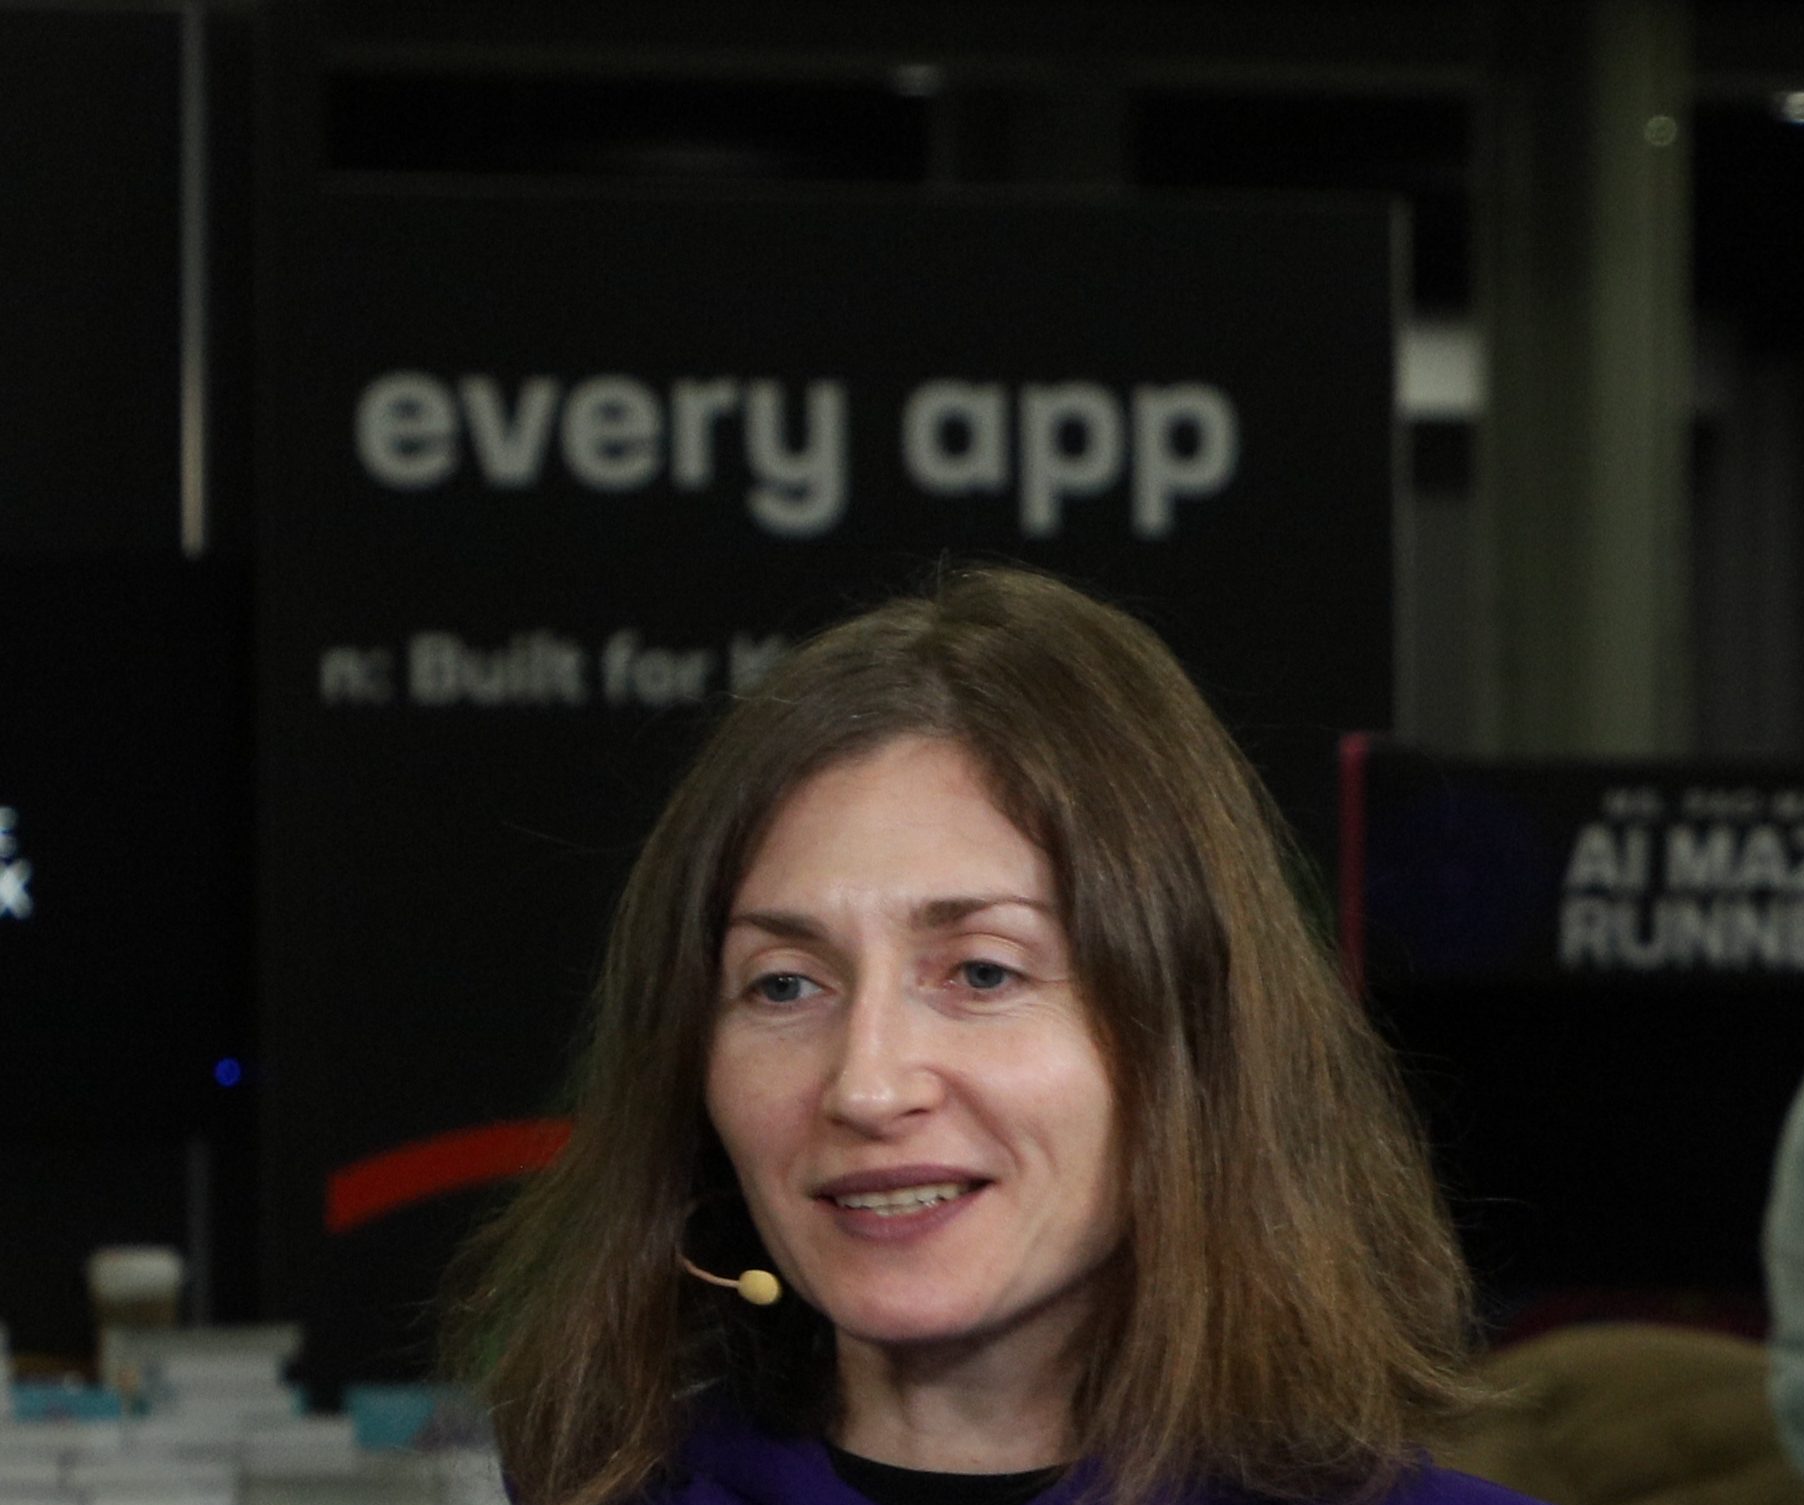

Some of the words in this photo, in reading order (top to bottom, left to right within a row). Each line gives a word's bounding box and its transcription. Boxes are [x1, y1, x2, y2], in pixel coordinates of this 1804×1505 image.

[355, 369, 851, 537] every
[899, 377, 1240, 538] app
[408, 629, 583, 704] Built
[603, 628, 710, 704] for
[1563, 822, 1655, 895] AI
